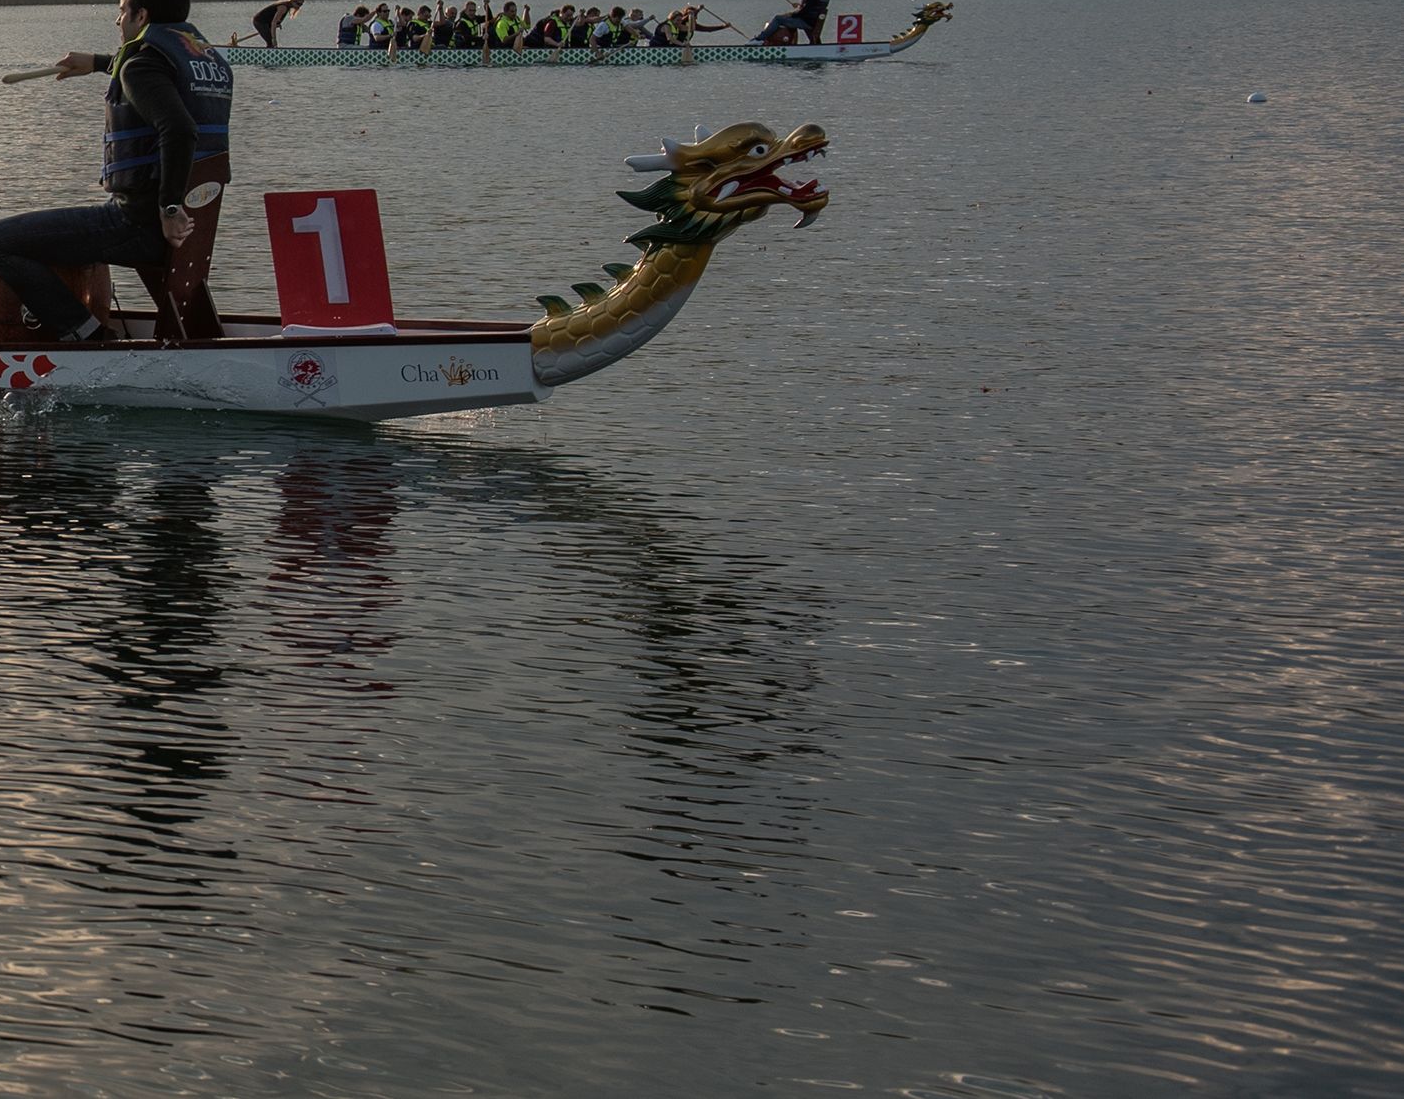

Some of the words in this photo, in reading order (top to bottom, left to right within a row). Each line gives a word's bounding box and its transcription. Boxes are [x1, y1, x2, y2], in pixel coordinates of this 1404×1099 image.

[841, 16, 858, 39] 2
[189, 60, 229, 83] BDBs
[292, 197, 350, 304] 1
